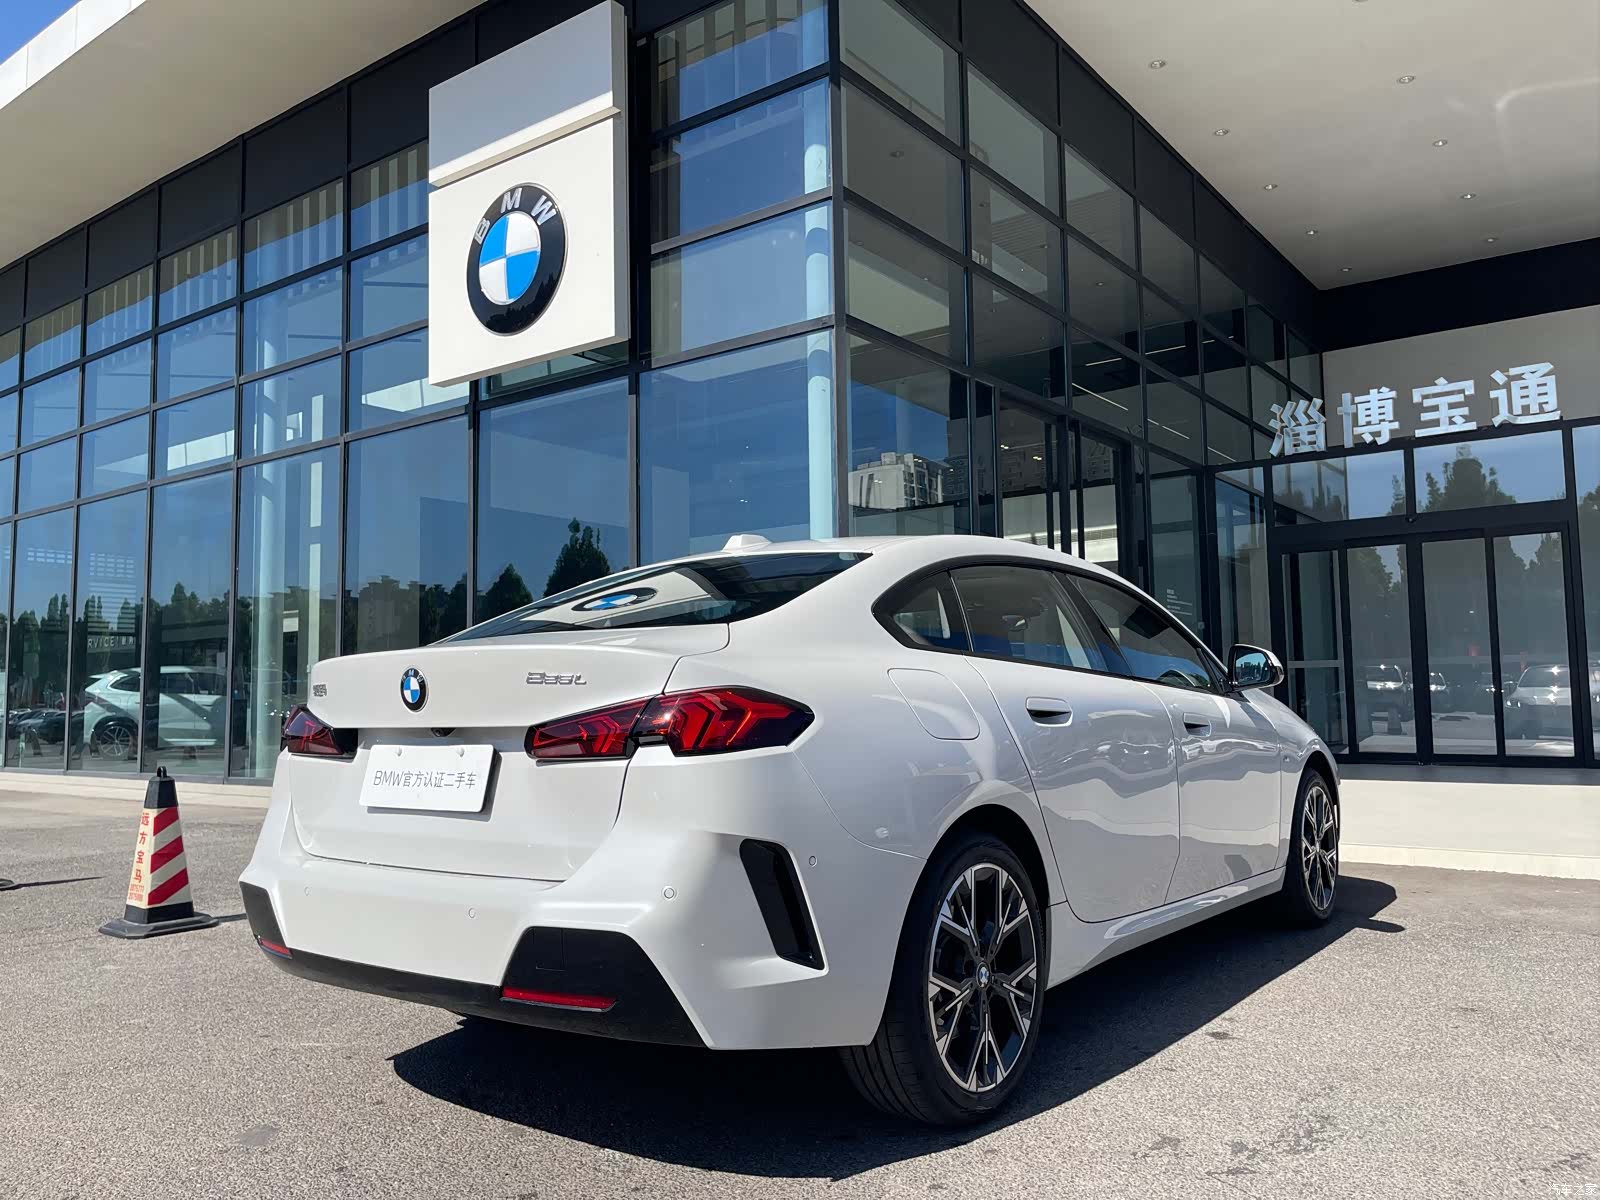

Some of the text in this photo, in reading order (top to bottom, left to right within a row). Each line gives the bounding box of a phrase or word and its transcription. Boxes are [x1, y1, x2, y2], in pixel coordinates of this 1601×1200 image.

[474, 187, 557, 245] BMW
[1268, 361, 1562, 457] 淄博宝通
[373, 770, 477, 789] BMW官方认证二手车
[133, 812, 150, 883] 远方宝马
